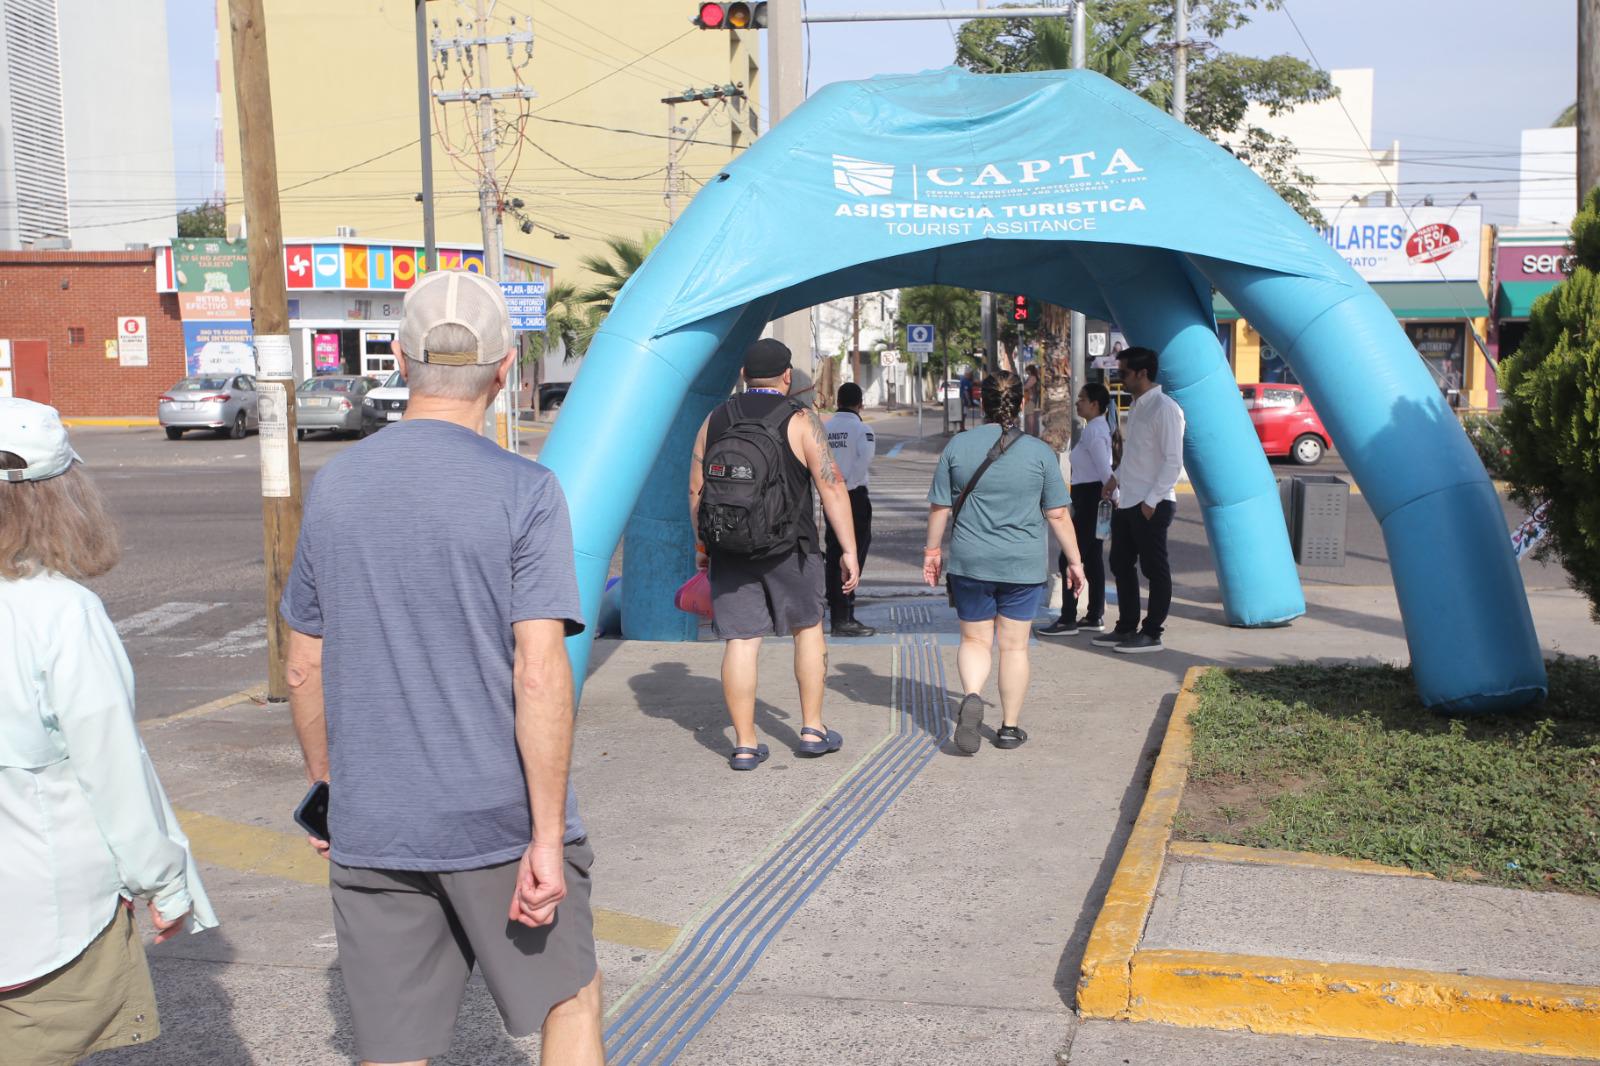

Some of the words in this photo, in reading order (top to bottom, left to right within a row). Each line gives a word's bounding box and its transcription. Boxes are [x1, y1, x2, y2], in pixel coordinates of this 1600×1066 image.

[926, 148, 1144, 187] CAPTA
[834, 203, 995, 219] ASISTENCIA
[1001, 197, 1147, 218] TURISTICA
[885, 222, 973, 236] TOURIST
[982, 217, 1097, 235] ASSITANCE
[1413, 229, 1451, 254] 75%
[507, 285, 523, 294] PLAYA
[527, 285, 545, 295] BEACH
